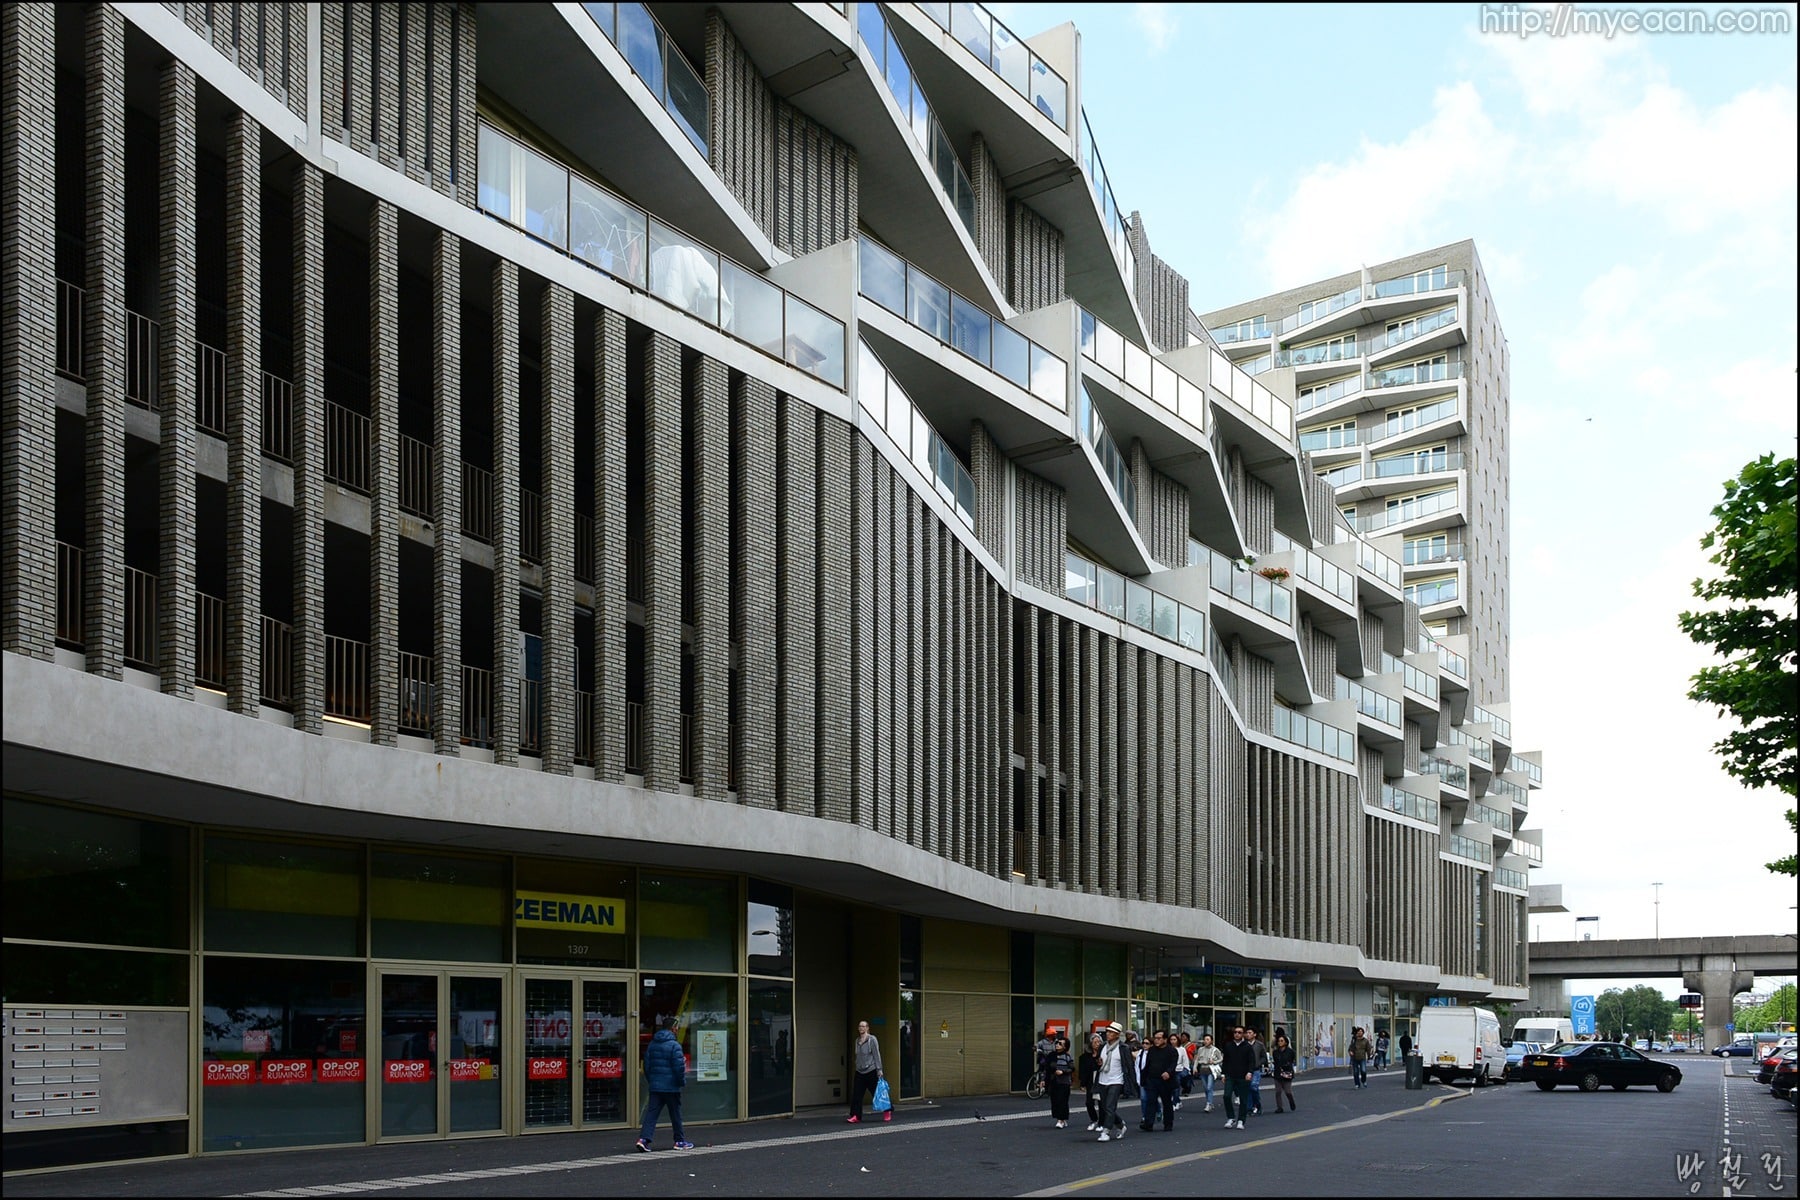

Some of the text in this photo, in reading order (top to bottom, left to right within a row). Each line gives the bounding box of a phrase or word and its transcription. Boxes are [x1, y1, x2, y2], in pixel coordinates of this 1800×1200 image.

[515, 898, 614, 926] ZEEMAN
[568, 945, 589, 954] 1307
[268, 1063, 306, 1072] OP=OP
[322, 1062, 360, 1071] OP=OP
[390, 1063, 425, 1071] OP=OP
[590, 1060, 617, 1068] OP=OP
[208, 1064, 249, 1073] OP=OP
[208, 1072, 250, 1080] RUIMING!
[267, 1071, 307, 1079] RUIMING!
[322, 1070, 360, 1078] RUIMING!
